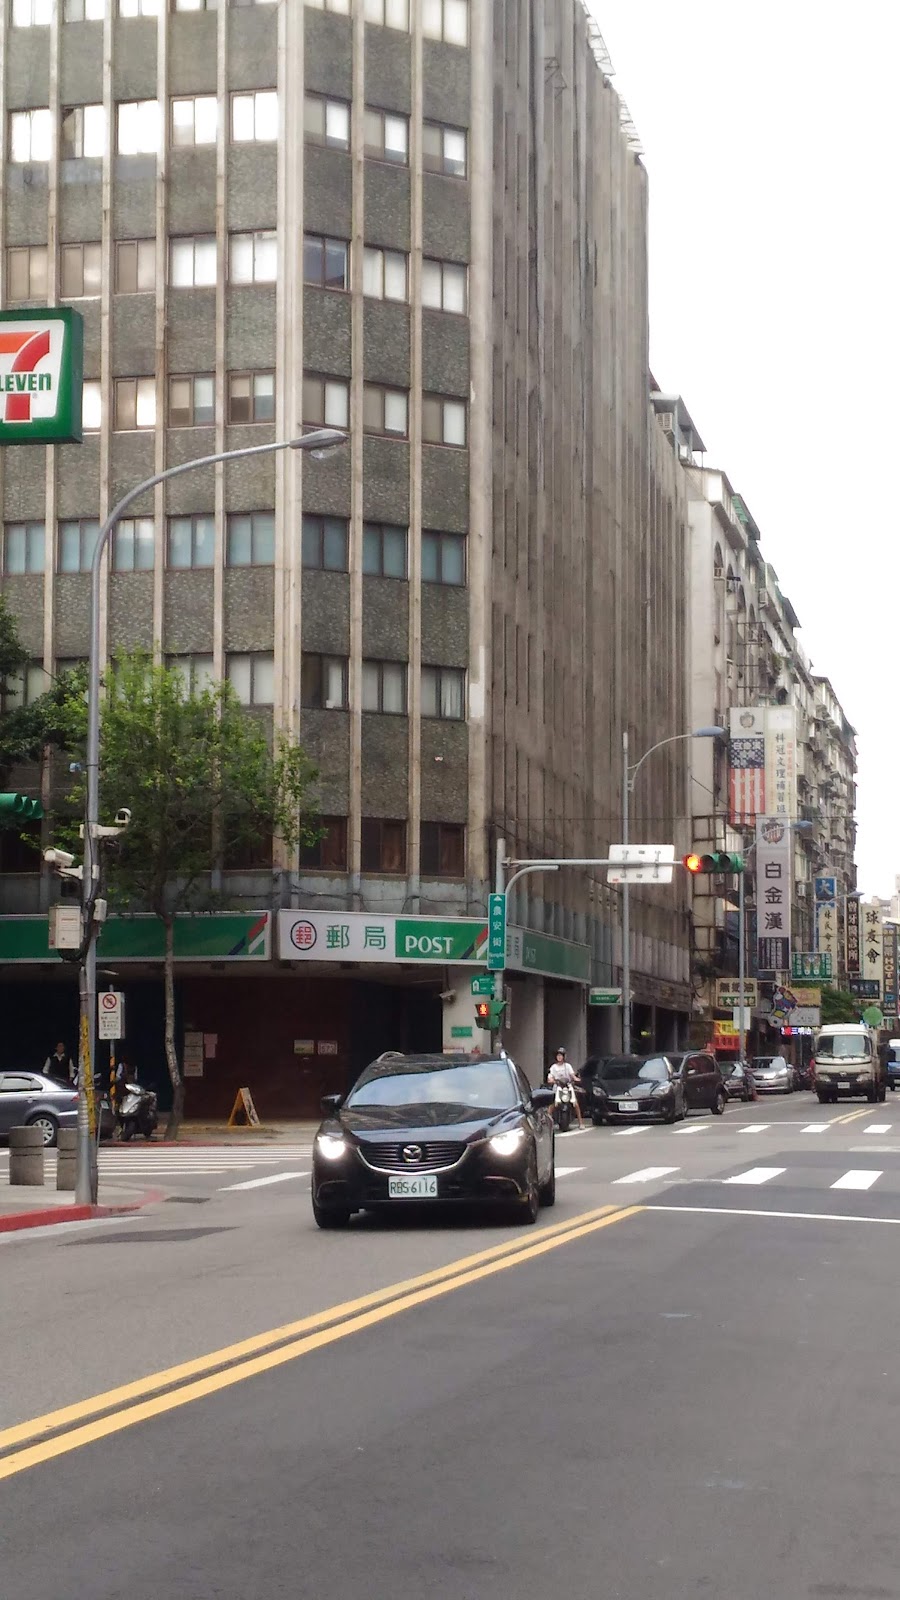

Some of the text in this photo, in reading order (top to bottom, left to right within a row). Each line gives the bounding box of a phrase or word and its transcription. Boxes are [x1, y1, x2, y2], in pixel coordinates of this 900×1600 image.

[764, 862, 783, 930] 白金漢
[326, 924, 386, 950] 郵局
[405, 936, 454, 954] POST
[865, 910, 880, 964] 球友會
